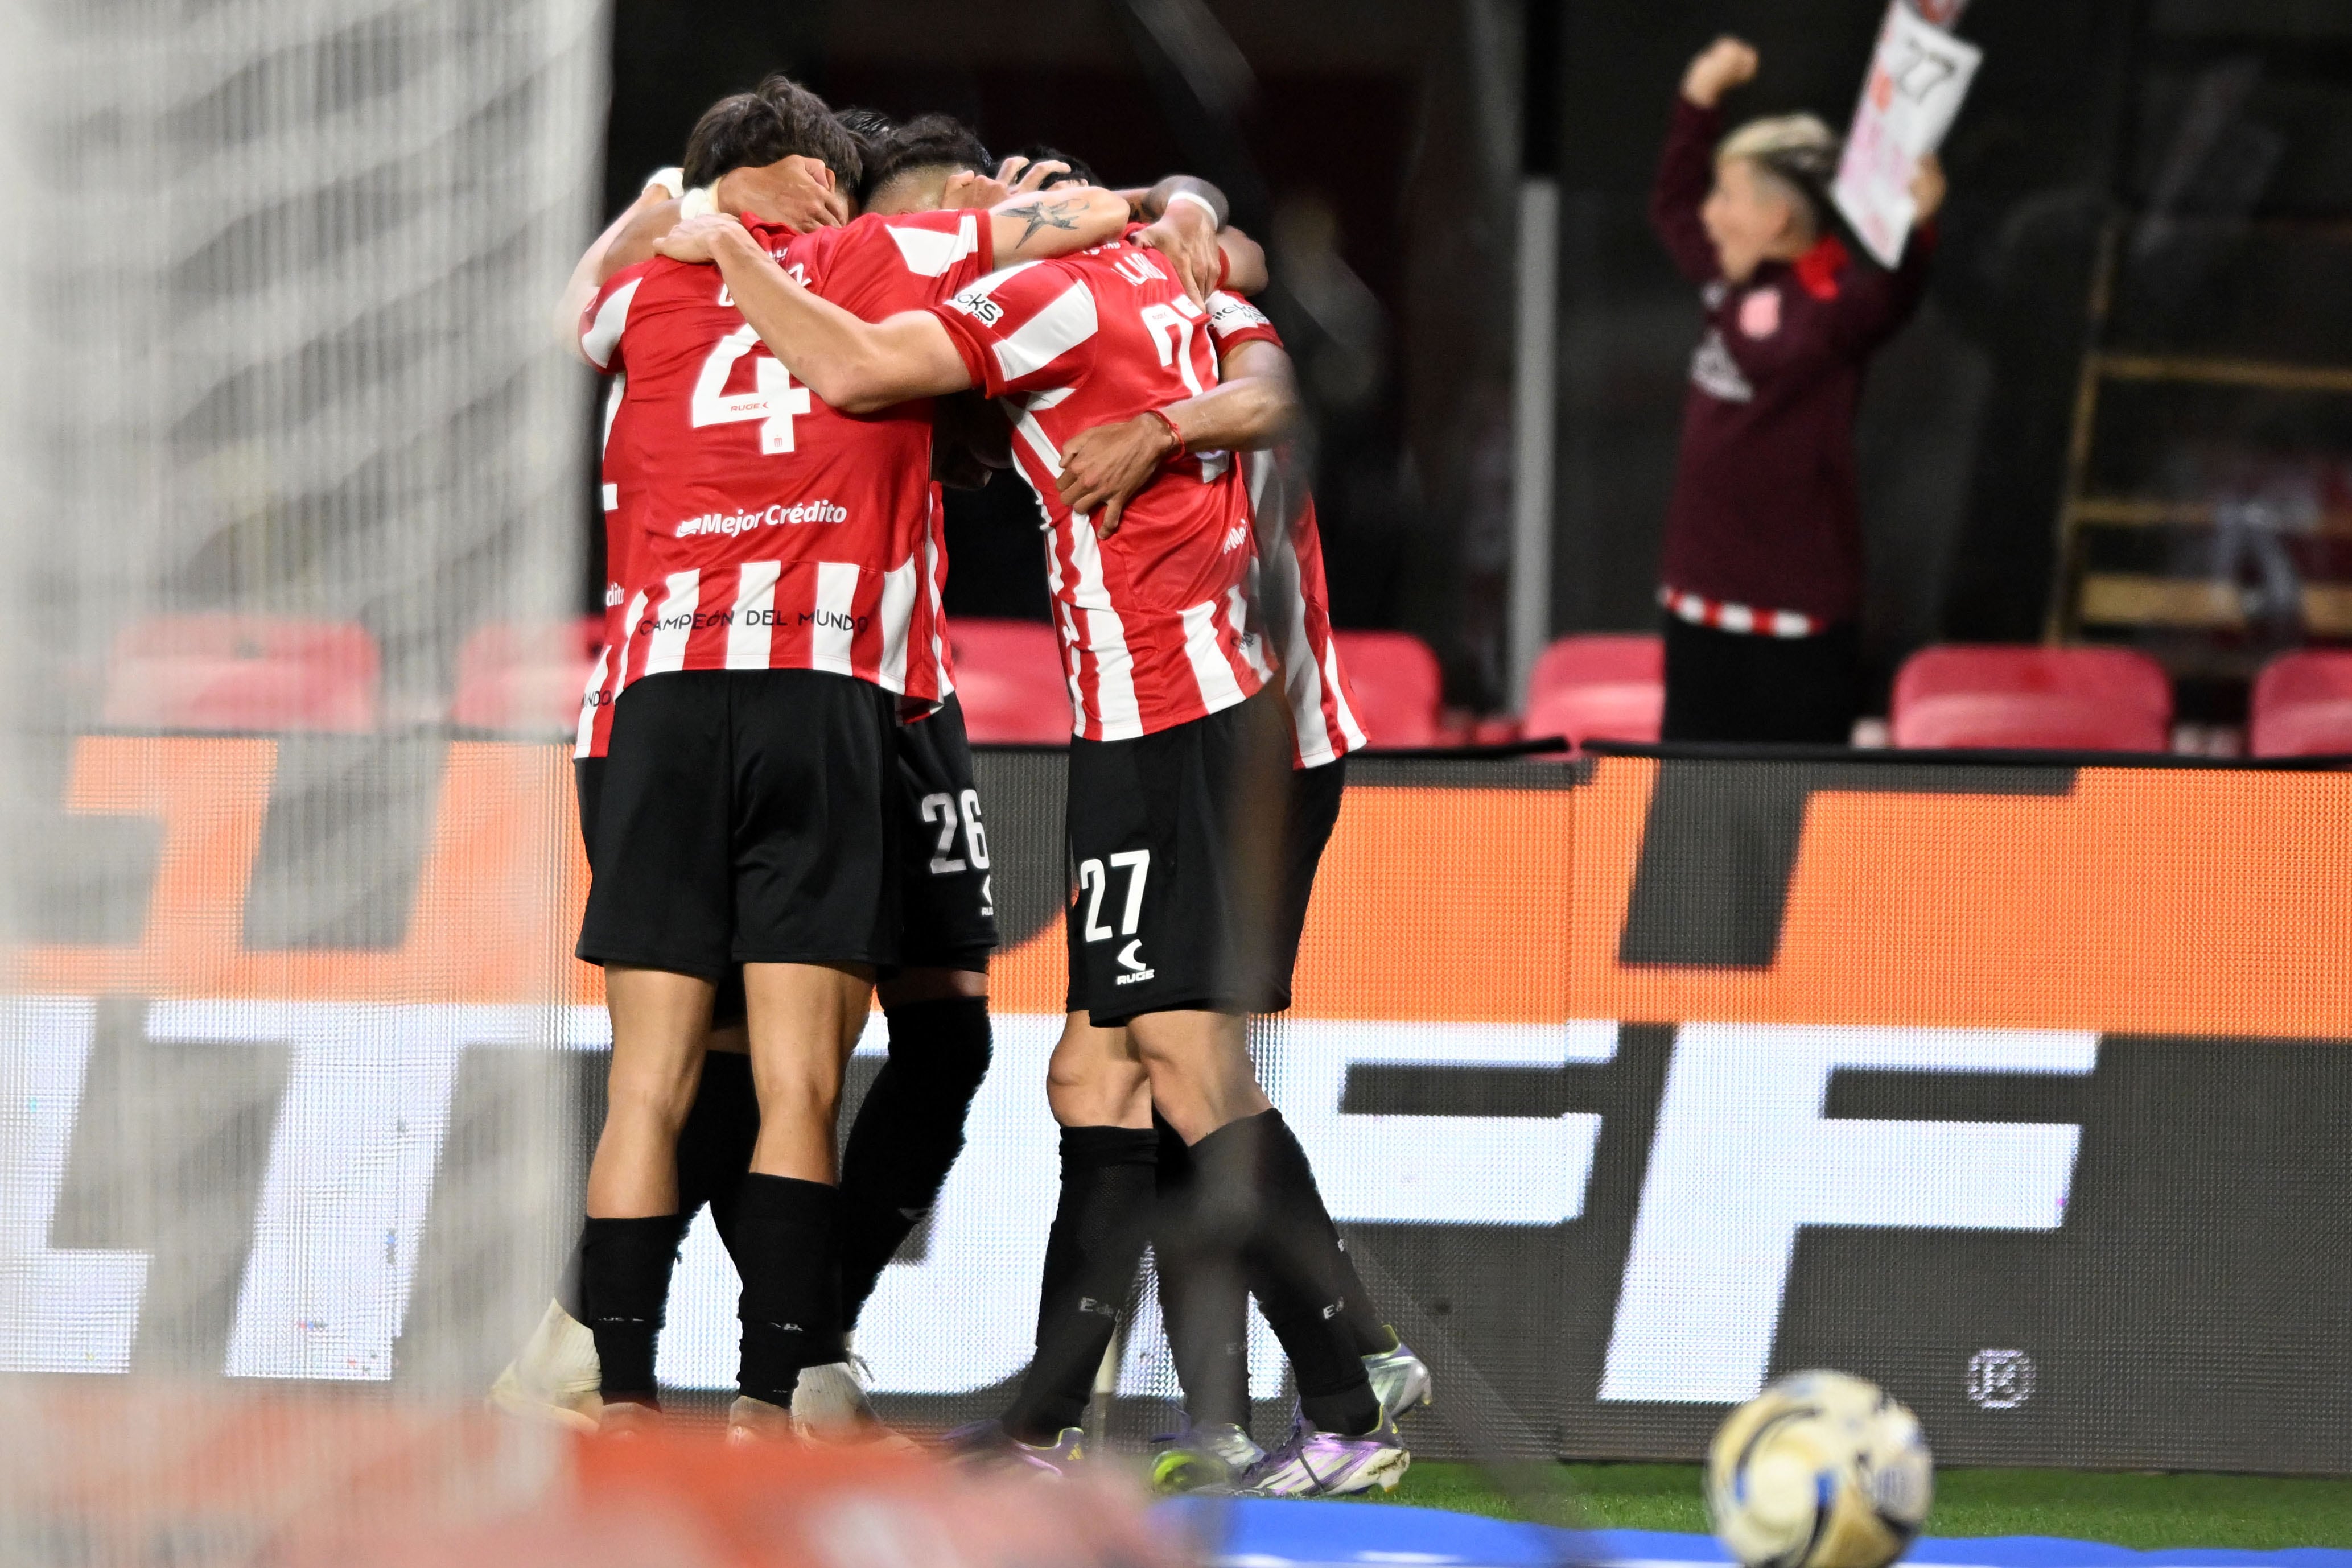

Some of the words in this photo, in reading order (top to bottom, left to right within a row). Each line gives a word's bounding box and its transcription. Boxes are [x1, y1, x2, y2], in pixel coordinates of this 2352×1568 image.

[691, 323, 811, 455] 4
[731, 403, 760, 412] RUGE
[700, 509, 764, 537] Mejor
[765, 500, 847, 525] Crédito
[640, 609, 735, 636] CAMPEÓN
[745, 609, 787, 626] DEL
[798, 609, 868, 633] MUNDO
[582, 690, 612, 708] NDO
[922, 789, 990, 874] 26
[1081, 849, 1150, 943] 27
[1117, 969, 1155, 985] RUGE
